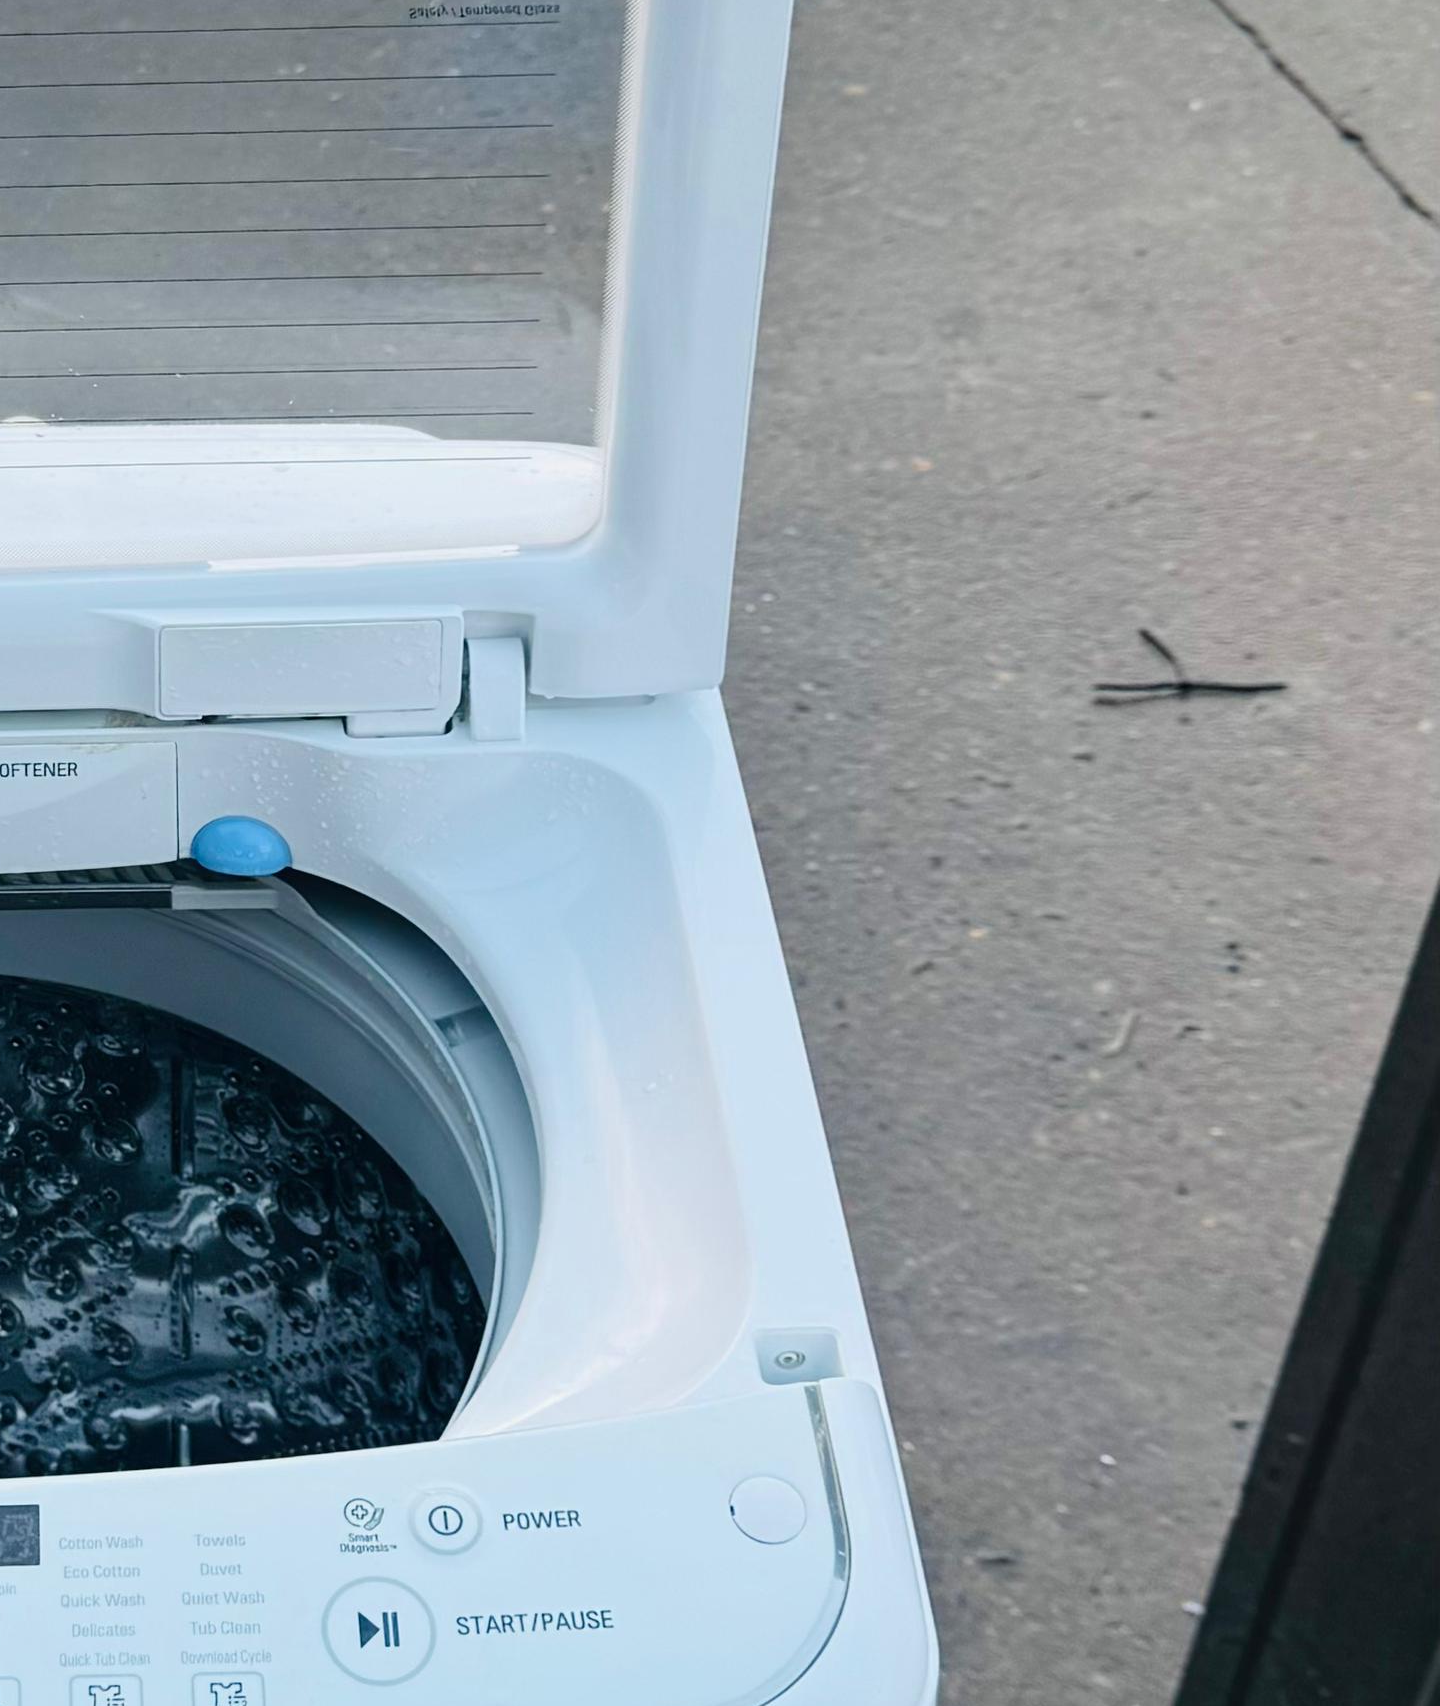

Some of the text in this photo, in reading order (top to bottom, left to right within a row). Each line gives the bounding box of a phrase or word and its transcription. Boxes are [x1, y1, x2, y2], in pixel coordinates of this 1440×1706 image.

[503, 1510, 582, 1531] POWER
[59, 1535, 144, 1550] Cotton Wash
[195, 1533, 246, 1547] Towels
[348, 1533, 379, 1543] Smart
[63, 1564, 141, 1579] Eco Cotton
[200, 1562, 242, 1576] Duvet
[60, 1593, 146, 1609] Quick Wash
[222, 1591, 265, 1605] Wash
[71, 1623, 136, 1637] Delicates
[191, 1620, 261, 1635] Tub Clean
[456, 1610, 614, 1636] START/PAUSE
[59, 1651, 151, 1668] Quick Tub Clean
[180, 1649, 272, 1665] Download Cycle
